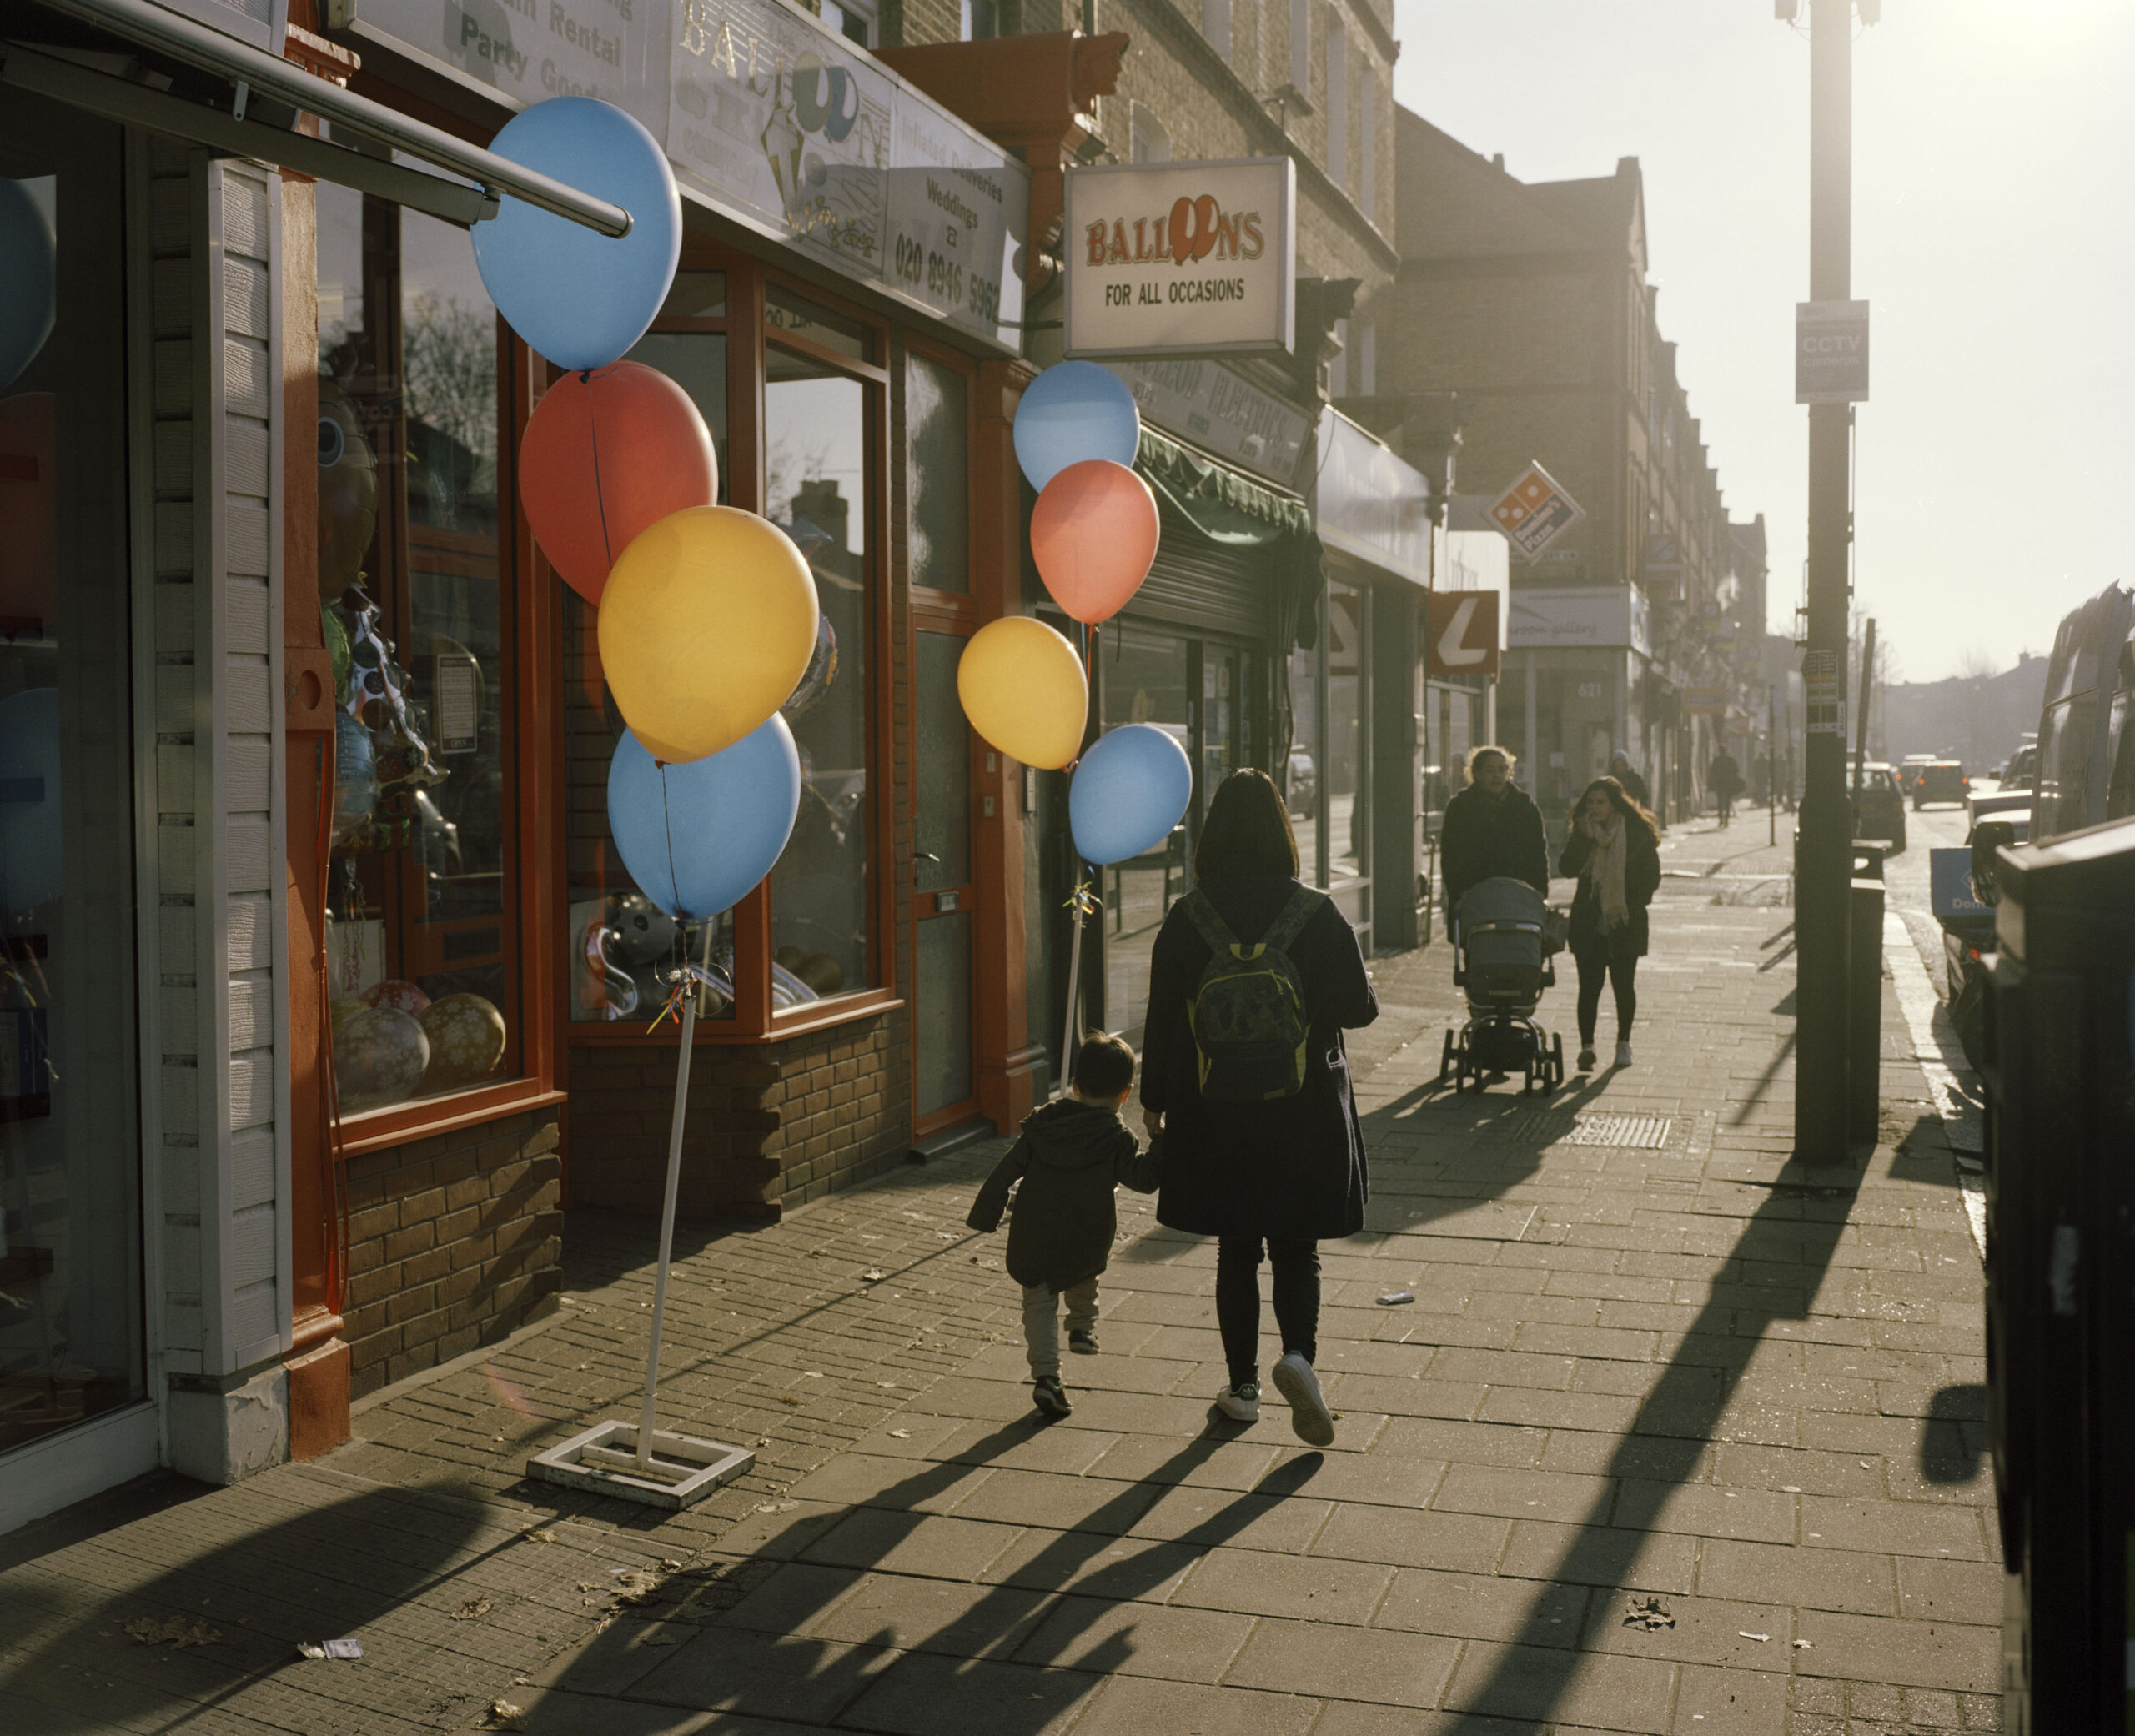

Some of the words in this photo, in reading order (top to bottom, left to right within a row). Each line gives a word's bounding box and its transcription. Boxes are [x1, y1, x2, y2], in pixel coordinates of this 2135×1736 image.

[461, 13, 529, 82] Party
[550, 1, 620, 68] Rental
[927, 177, 978, 229] Weddings
[951, 151, 1003, 203] Deliveries
[1086, 194, 1264, 267] BALLOONS
[896, 233, 922, 285] 020
[927, 250, 962, 304] 8946
[1106, 283, 1132, 307] FOR
[1138, 283, 1163, 306] ALL
[1168, 278, 1245, 304] OCCASIONS
[1801, 335, 1861, 353] CCTV
[1514, 499, 1562, 543] Domino's
[1523, 523, 1555, 552] Pizza
[1577, 680, 1602, 698] 621
